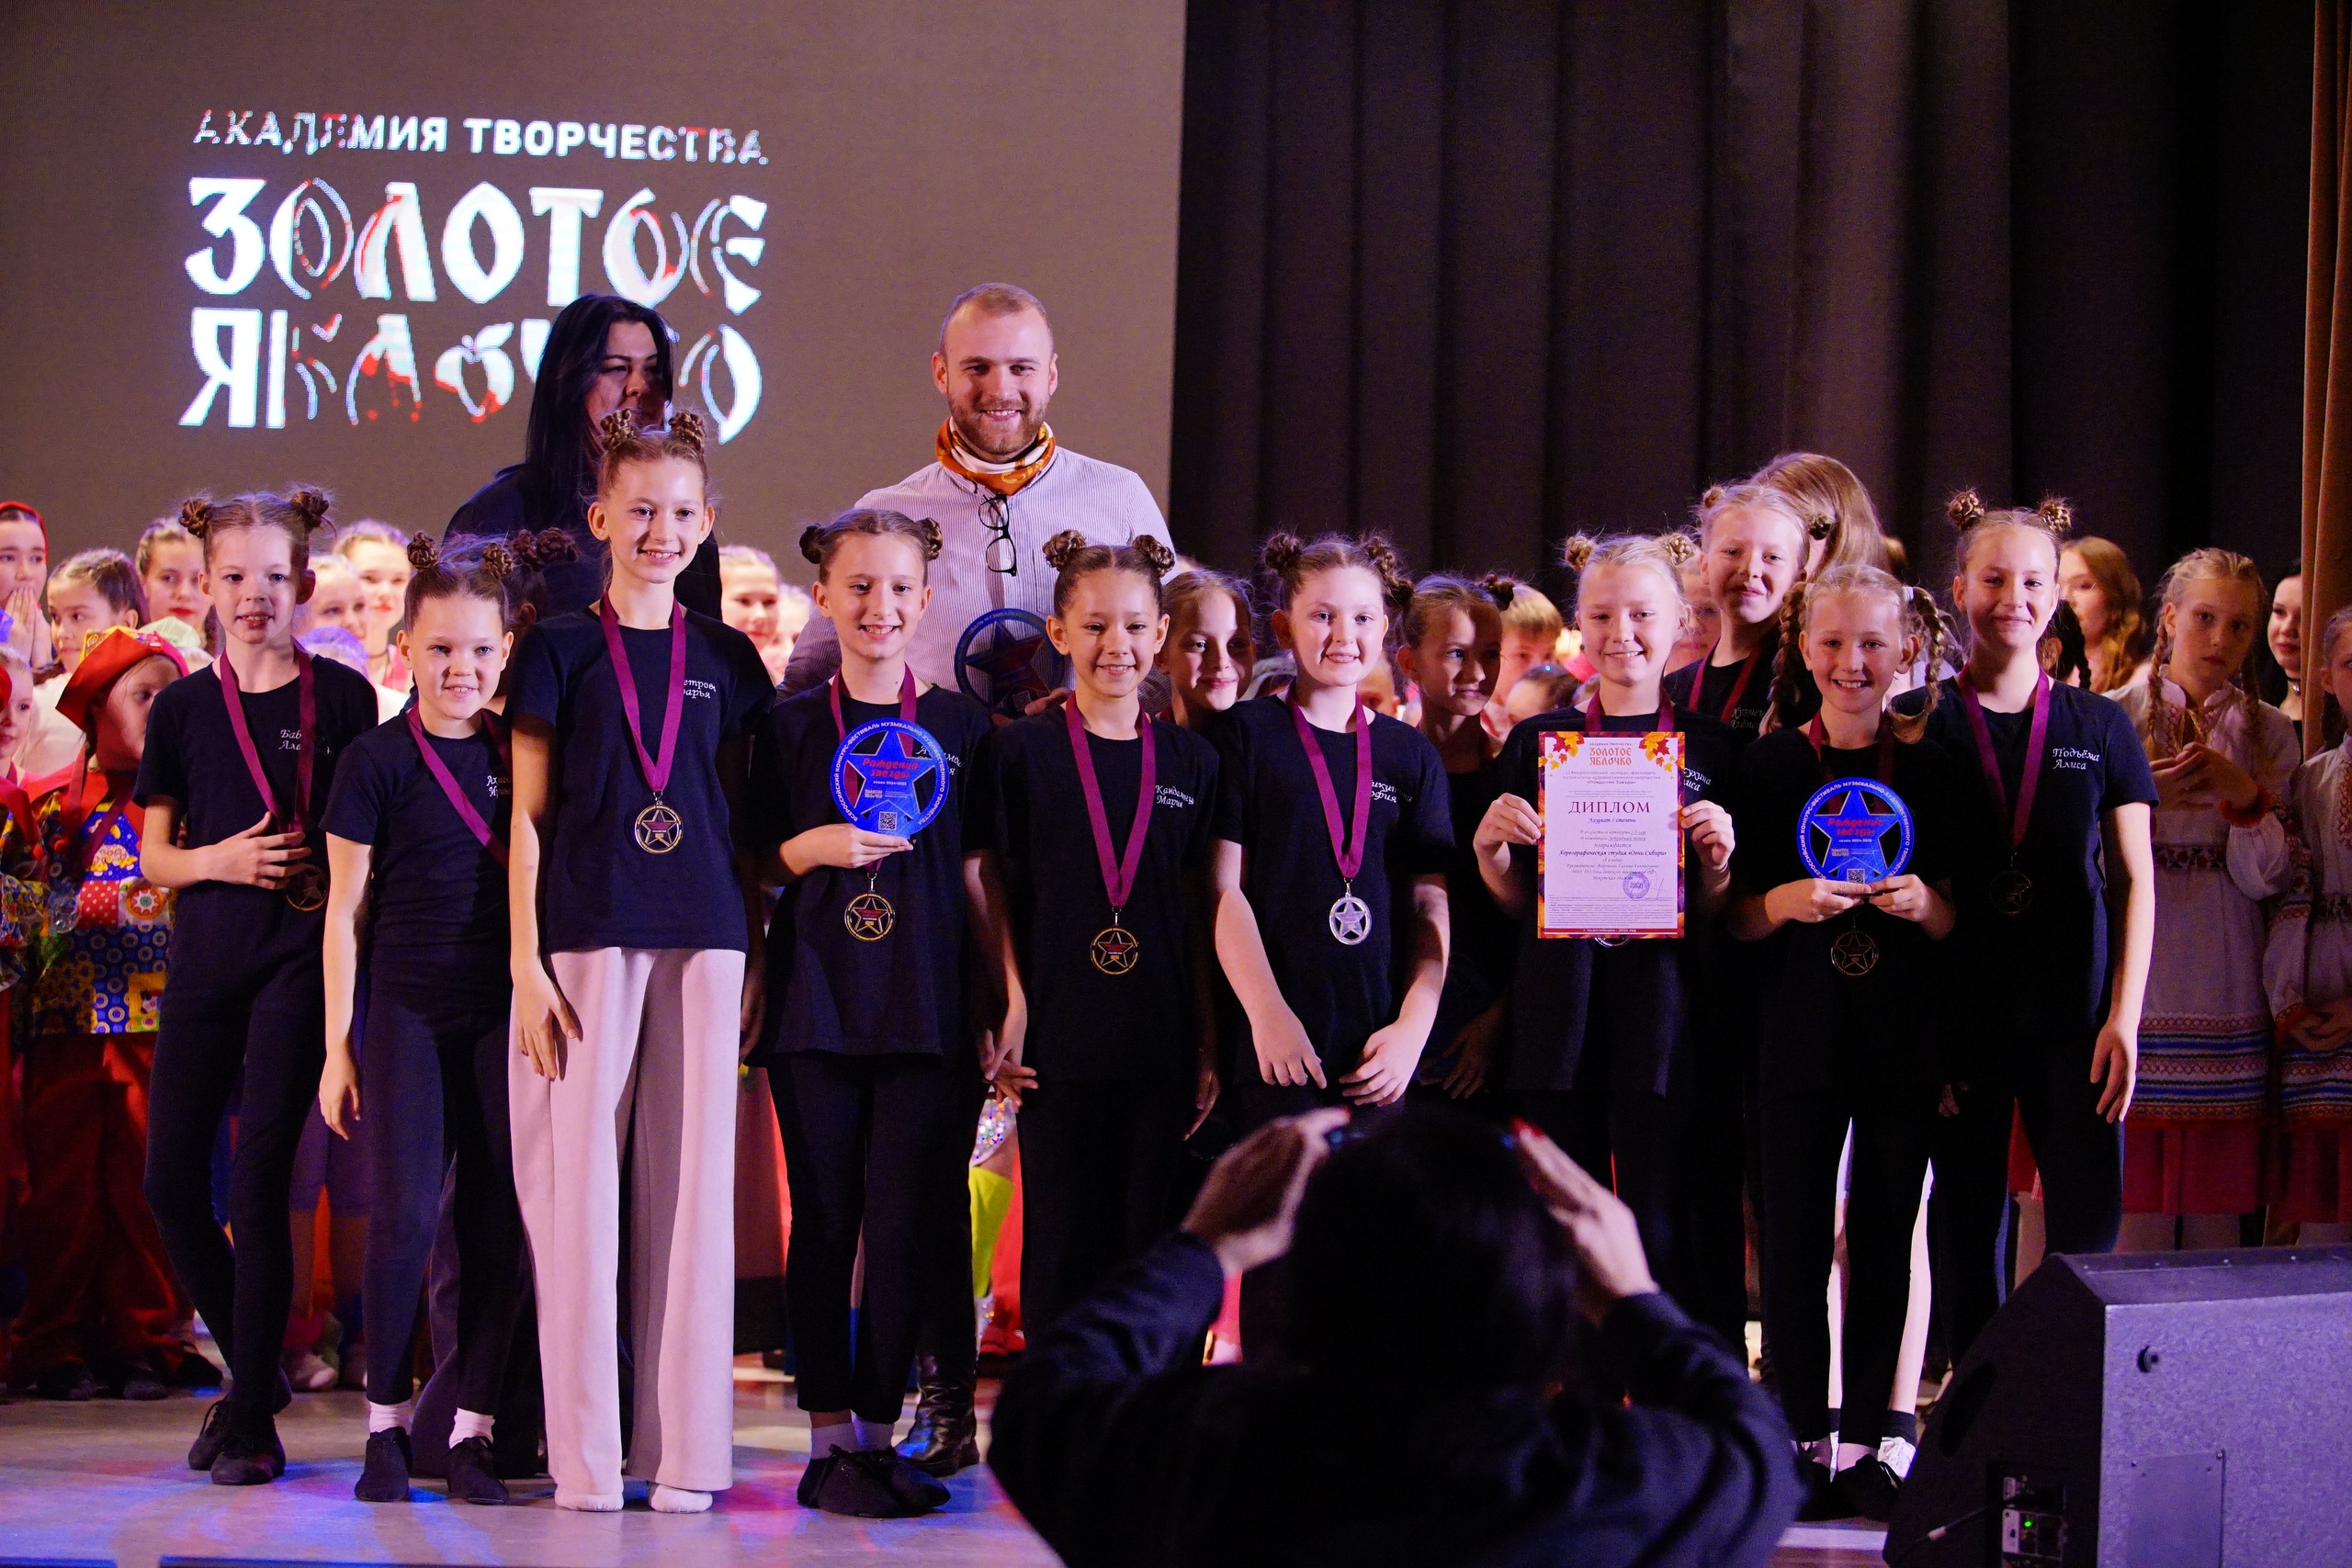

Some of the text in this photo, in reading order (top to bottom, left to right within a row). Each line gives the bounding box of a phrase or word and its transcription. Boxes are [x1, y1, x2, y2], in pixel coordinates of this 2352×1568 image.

[463, 118, 769, 165] ТВОРЧЕСТВА
[185, 176, 768, 317] ЗОЛОТОЕ
[833, 722, 879, 772] КОНКУРС-ФЕСТИВАЛЬ
[1589, 748, 1632, 756] ЗОЛОТОЕ
[1589, 757, 1632, 766] ЯБЛОЧКО
[2052, 759, 2086, 770] Алиса
[833, 773, 858, 822] ВСЕРОССИЙСКИЙ
[1156, 795, 1183, 808] Мария
[1568, 801, 1650, 814] ДИПЛОМ
[916, 793, 944, 826] ТВОРЧЕСТВА
